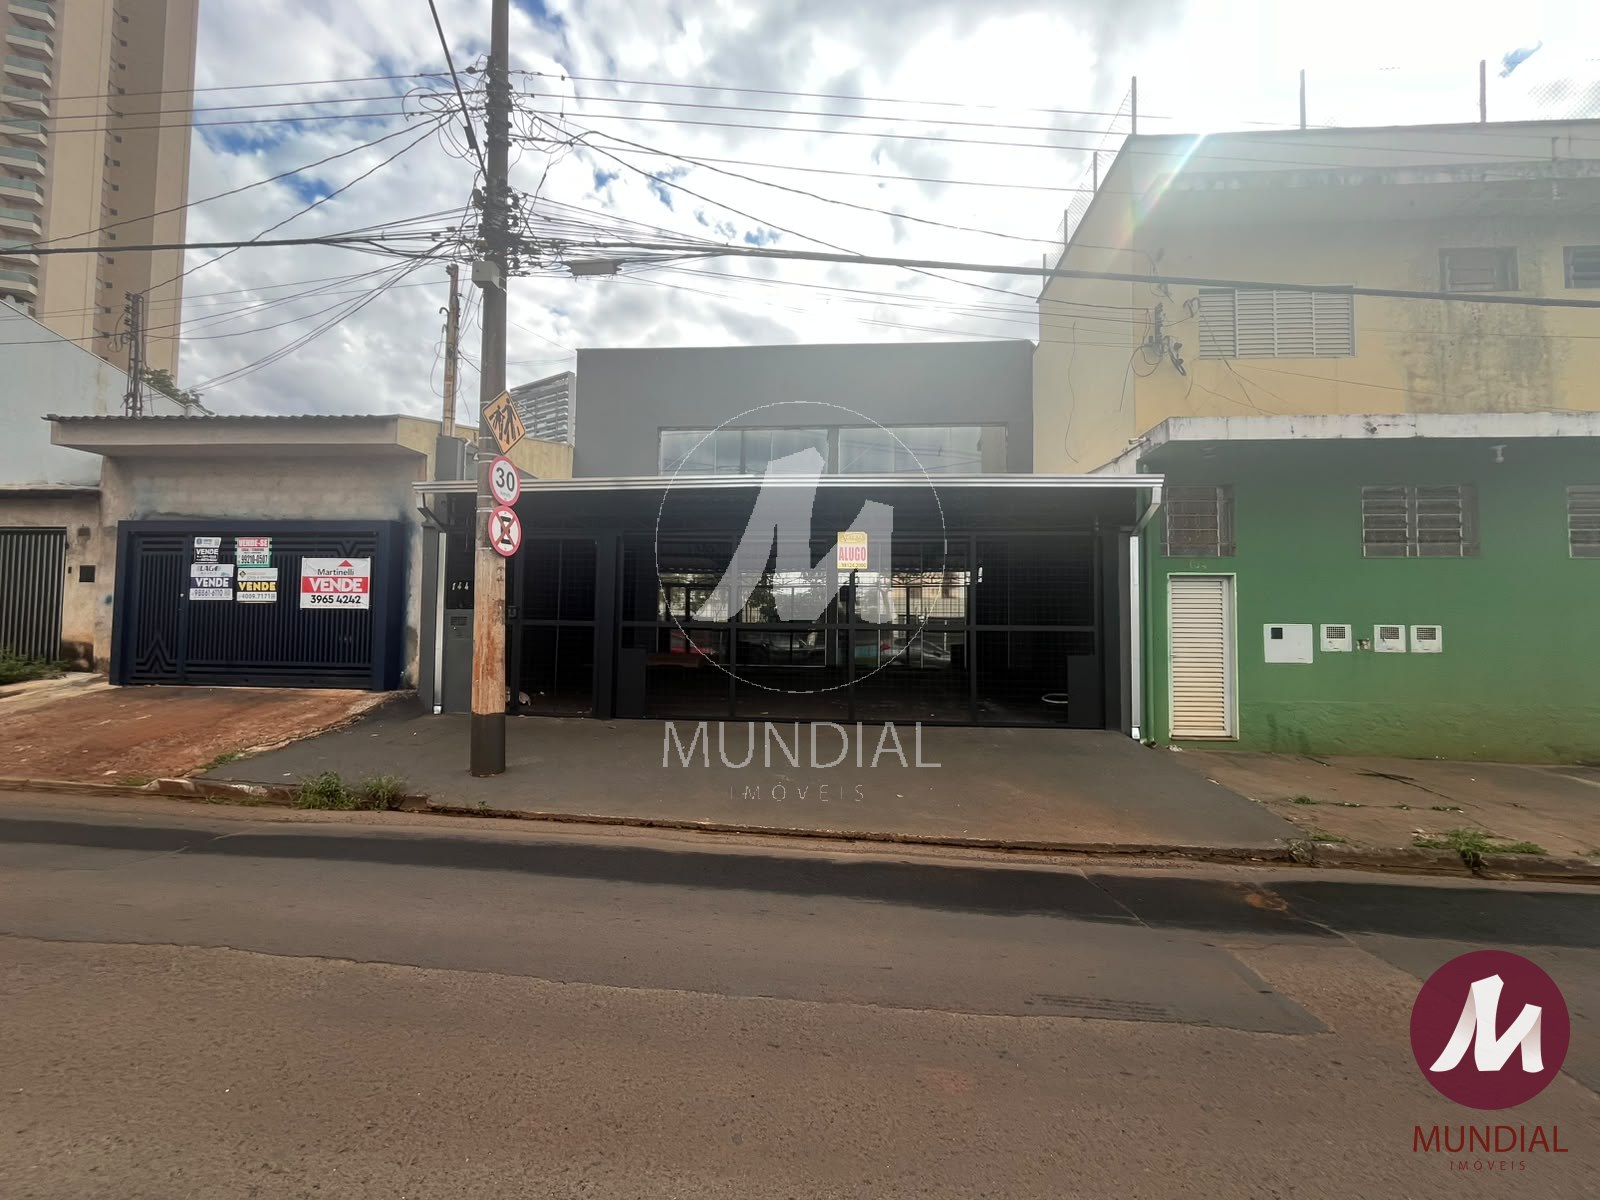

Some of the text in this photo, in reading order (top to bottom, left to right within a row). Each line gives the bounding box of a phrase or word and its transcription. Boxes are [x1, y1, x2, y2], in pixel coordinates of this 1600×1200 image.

[496, 467, 515, 492] 30
[238, 538, 268, 547] VENDE-SE
[839, 546, 867, 561] ALUGO
[317, 568, 355, 576] Martinelli
[195, 577, 230, 588] VENDE
[238, 581, 277, 591] VENDE
[308, 577, 363, 593] VENDE
[310, 594, 361, 604] 3965 4242
